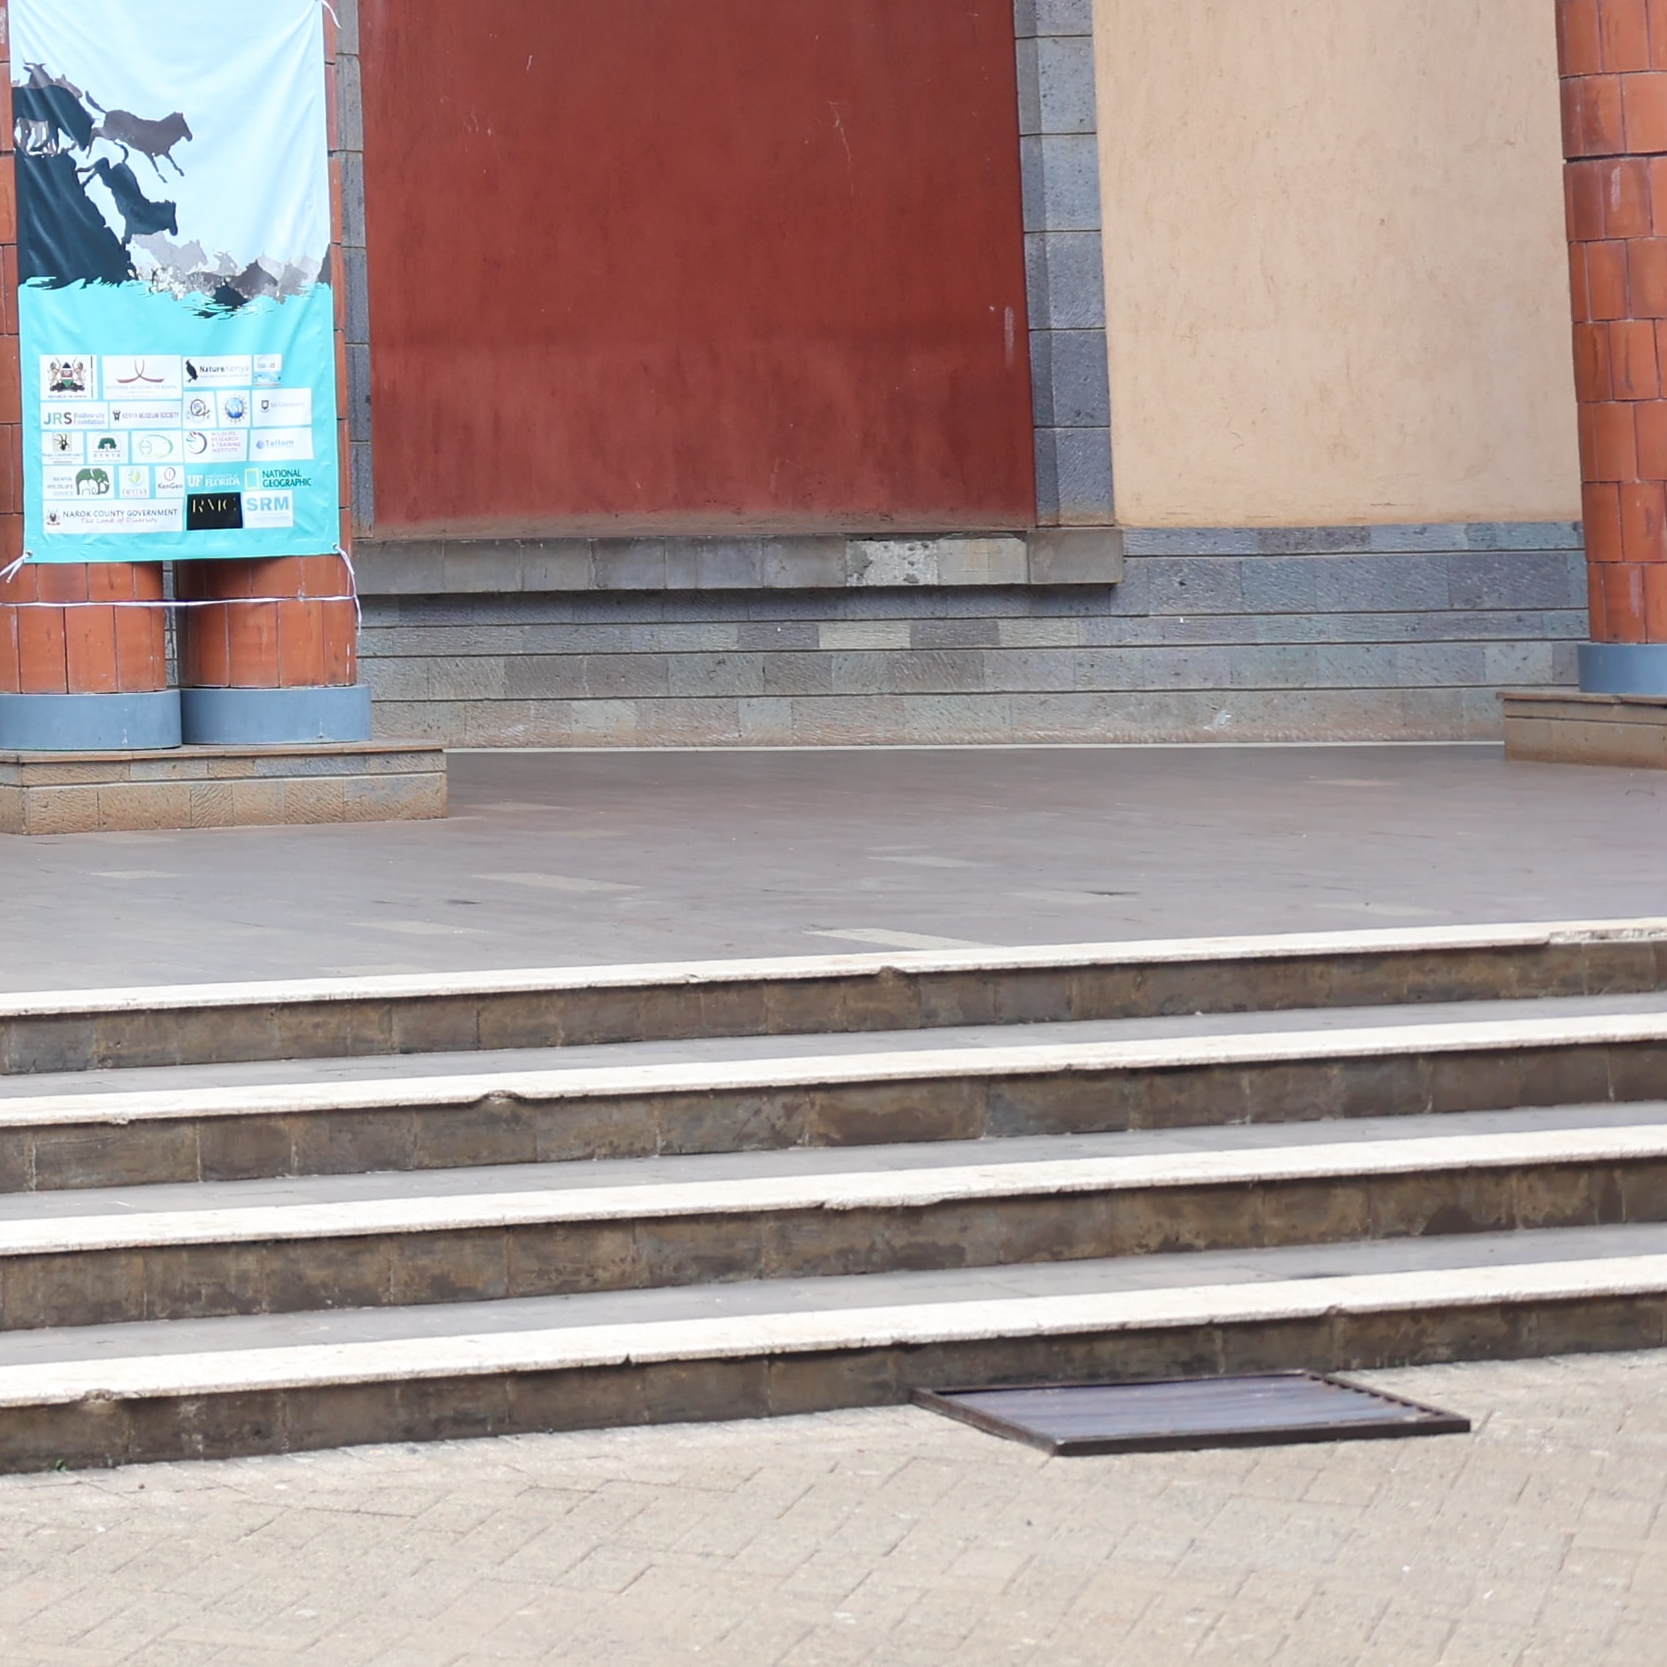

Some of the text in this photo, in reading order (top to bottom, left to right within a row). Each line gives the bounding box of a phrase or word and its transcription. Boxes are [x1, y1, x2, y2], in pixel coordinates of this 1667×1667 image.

[43, 412, 73, 425] JRS
[262, 469, 302, 479] NATIONAL
[187, 475, 204, 487] UF
[262, 477, 312, 488] GEOGRAPHIC
[247, 496, 290, 512] SRM
[62, 508, 178, 518] NAROK COUNTY GOVERNMENT
